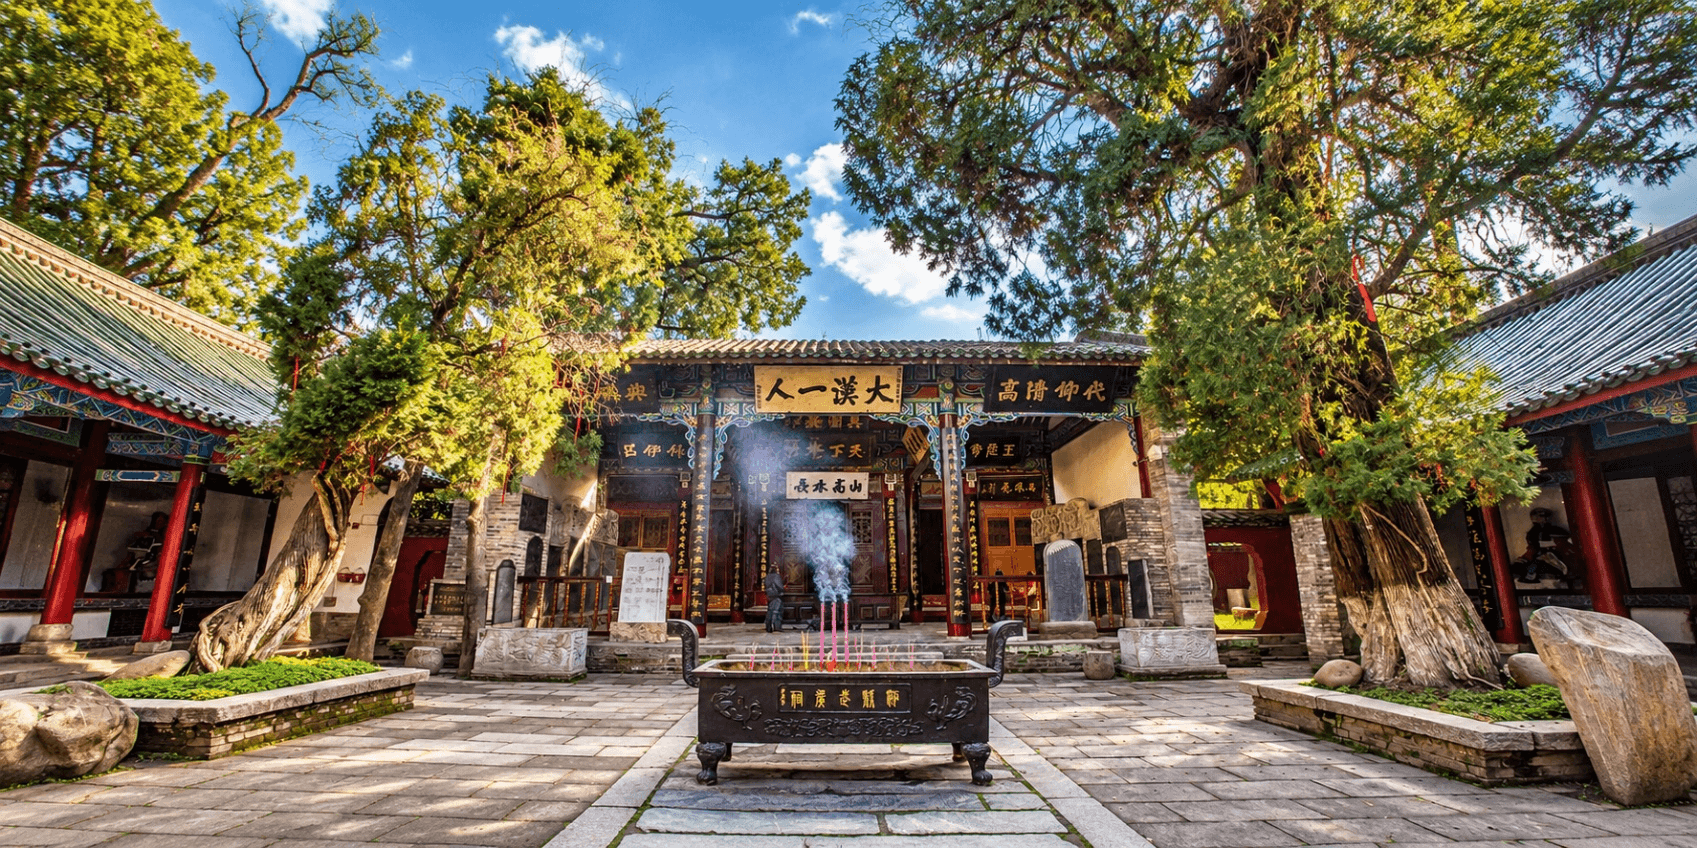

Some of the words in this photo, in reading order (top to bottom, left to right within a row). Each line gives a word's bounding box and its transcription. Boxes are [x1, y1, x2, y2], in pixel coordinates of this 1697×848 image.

[765, 374, 894, 406] 大漢一人
[998, 378, 1106, 402] 代仰清高
